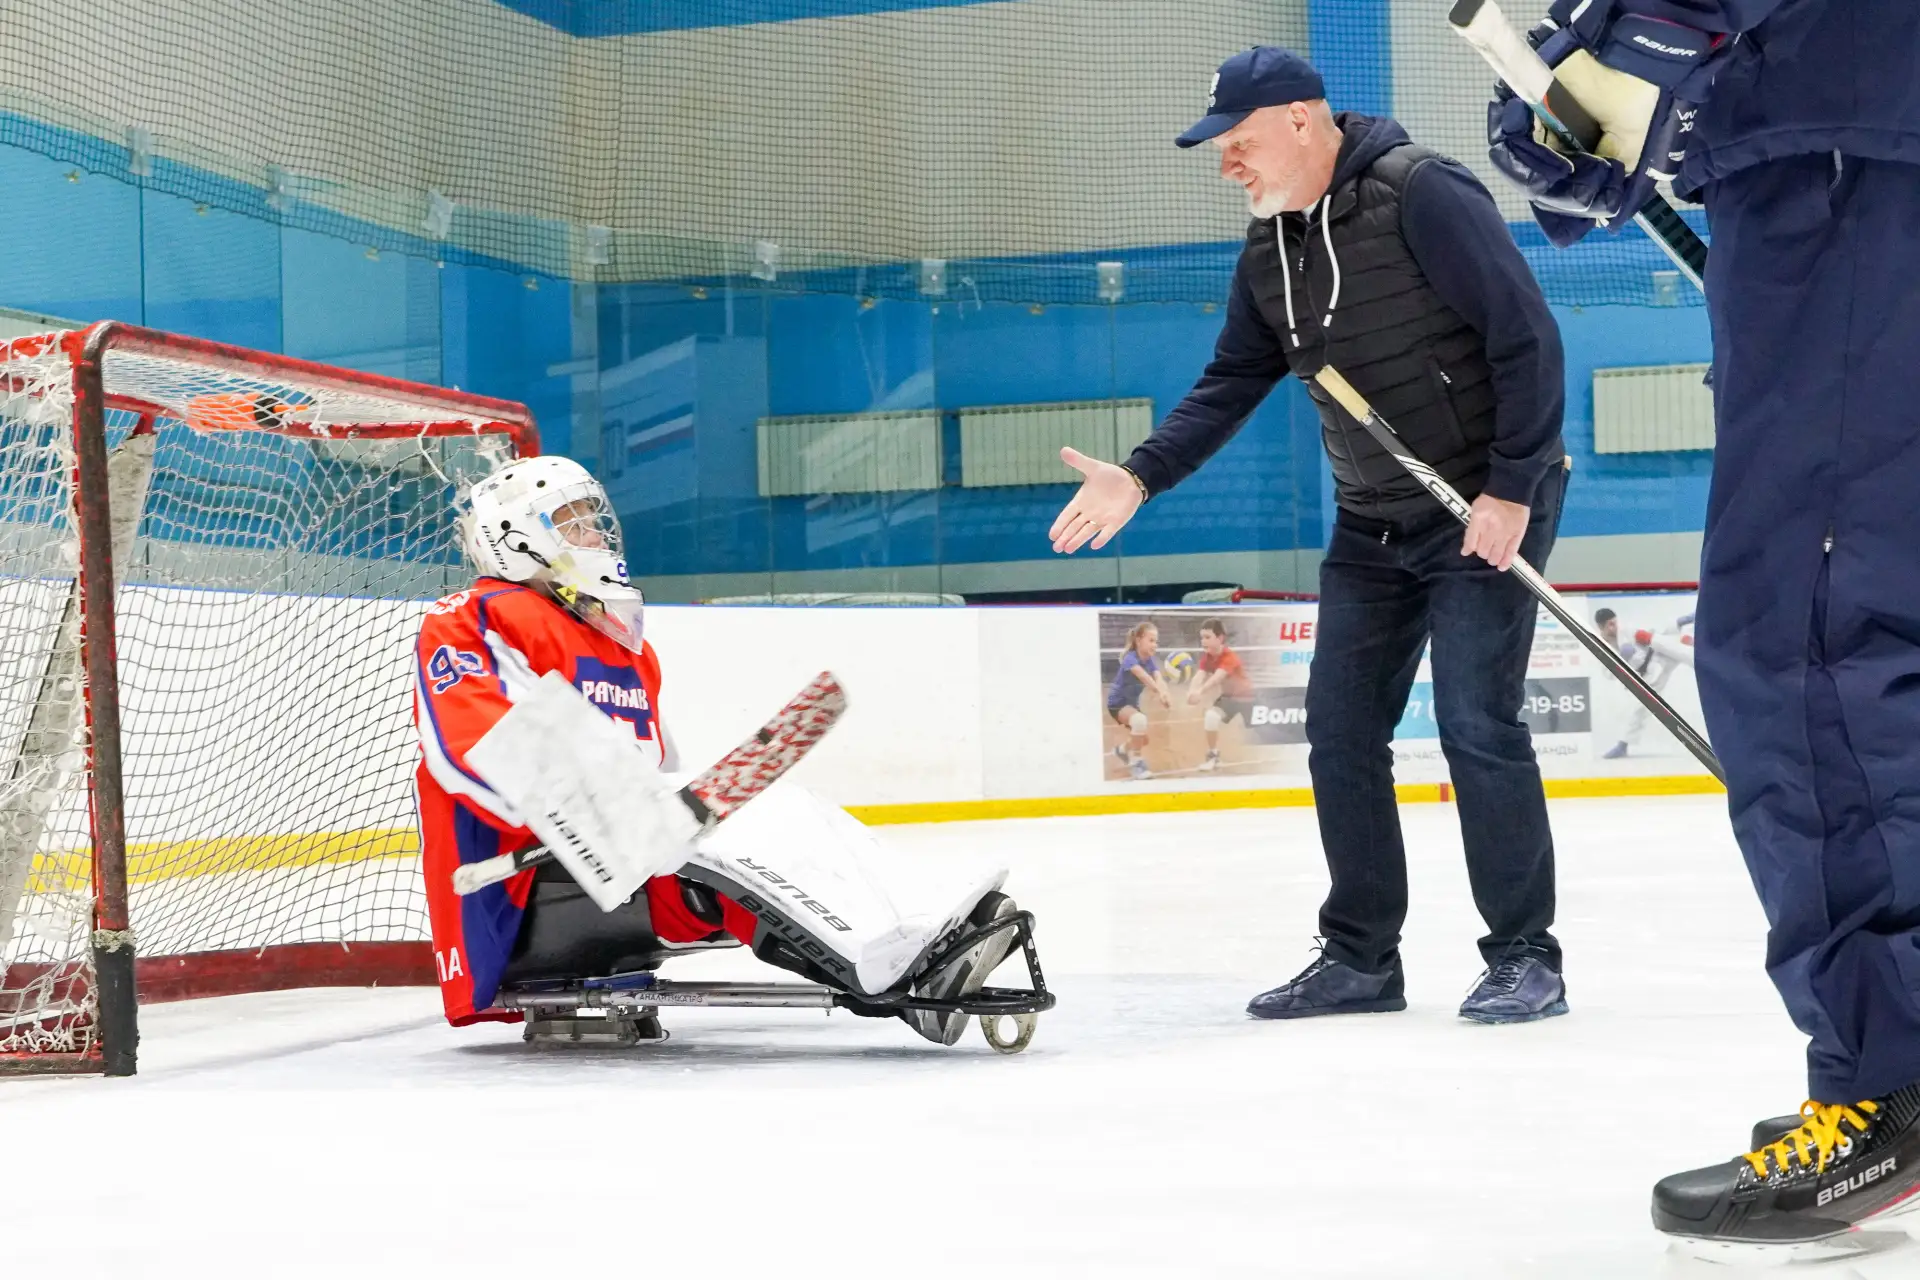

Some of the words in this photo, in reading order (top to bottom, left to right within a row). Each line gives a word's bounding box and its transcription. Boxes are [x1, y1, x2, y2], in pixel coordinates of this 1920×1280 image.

[1632, 35, 1697, 57] BAUER
[1280, 622, 1317, 643] ЦЕ
[547, 810, 614, 884] BAUER
[736, 857, 852, 932] BAUER
[737, 894, 848, 976] BAUER
[1817, 1157, 1897, 1207] BAUER
